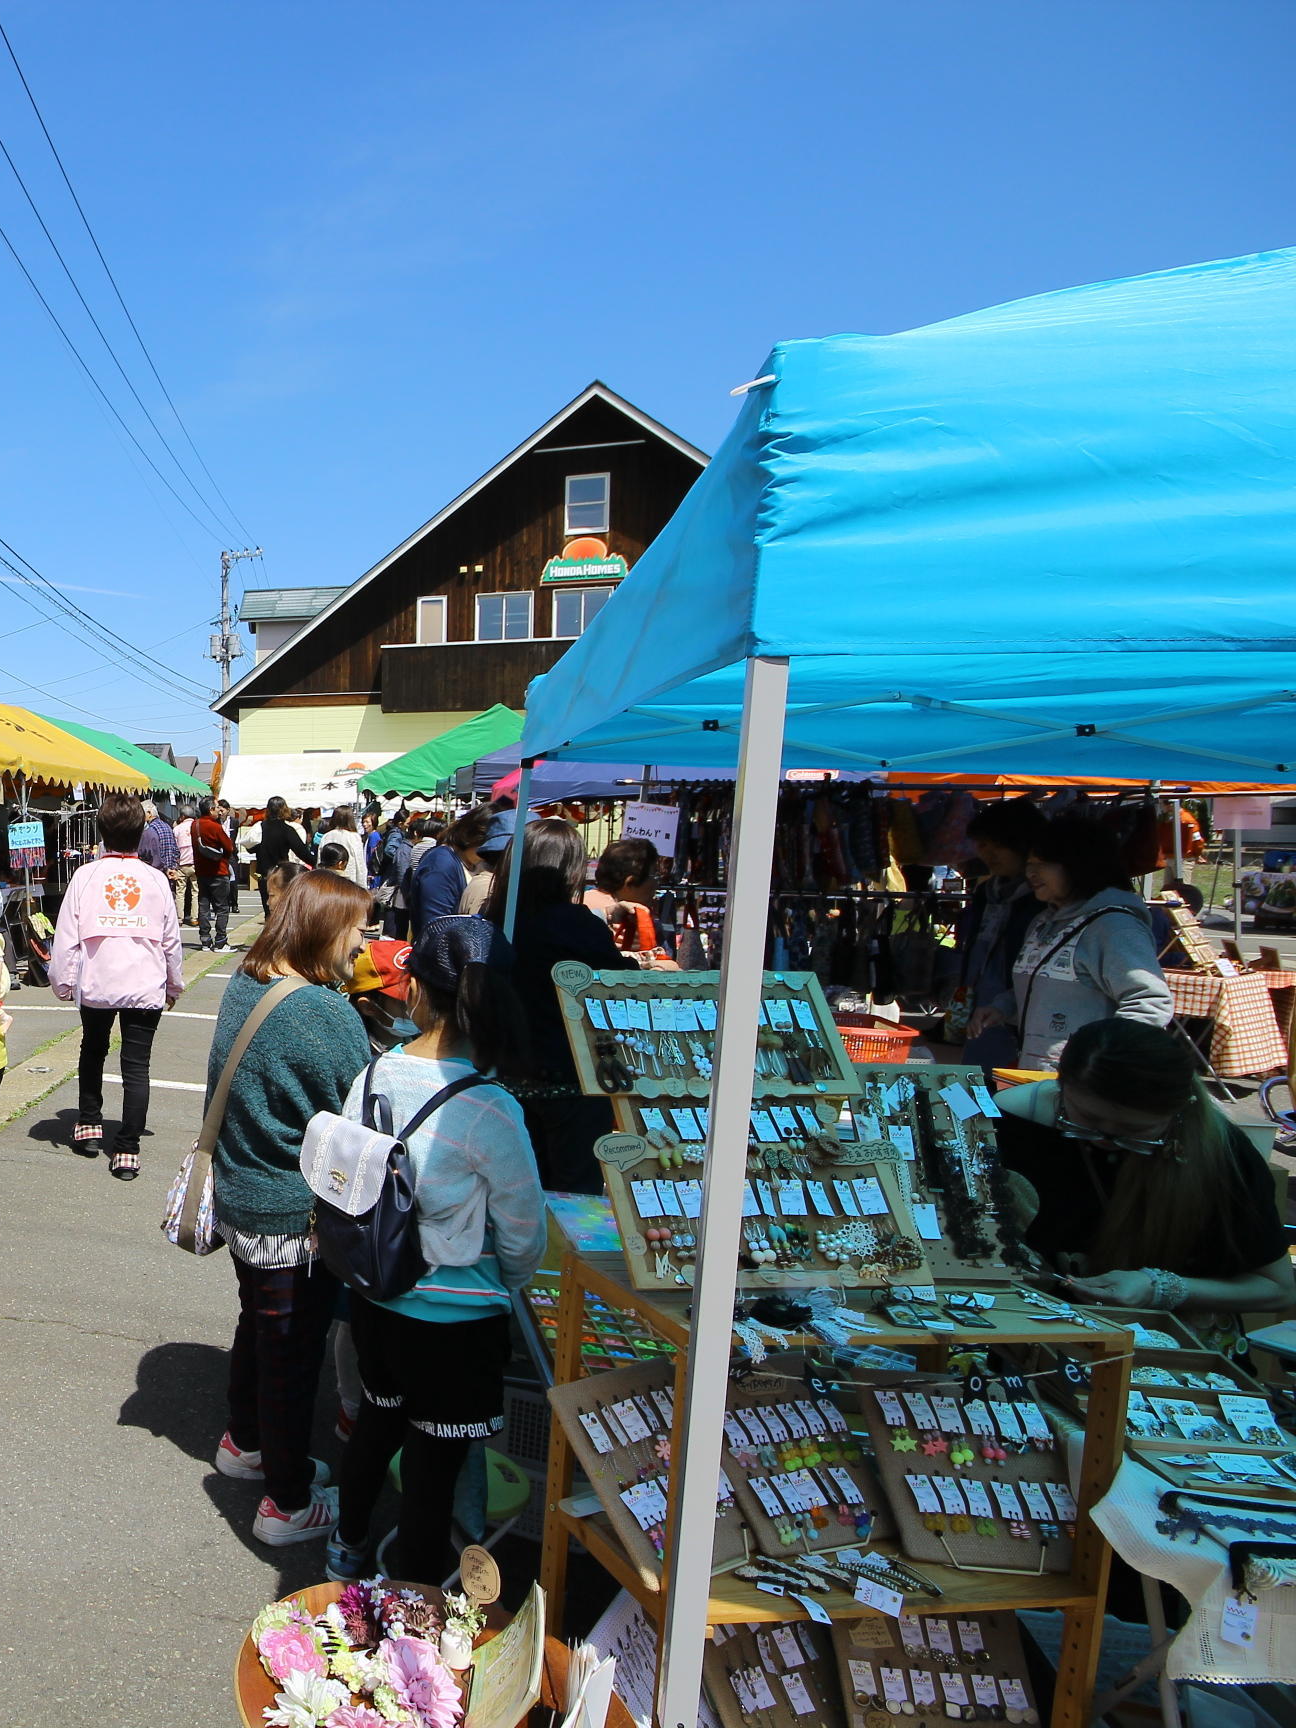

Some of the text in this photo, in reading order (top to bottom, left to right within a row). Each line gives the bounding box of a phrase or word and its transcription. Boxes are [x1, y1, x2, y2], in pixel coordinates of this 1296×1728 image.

[549, 563, 621, 578] HONDA HOMES
[98, 915, 147, 928] ママエール
[603, 1141, 642, 1155] Recommend
[1004, 1375, 1023, 1388] m
[437, 1421, 492, 1438] ANAPGIRL
